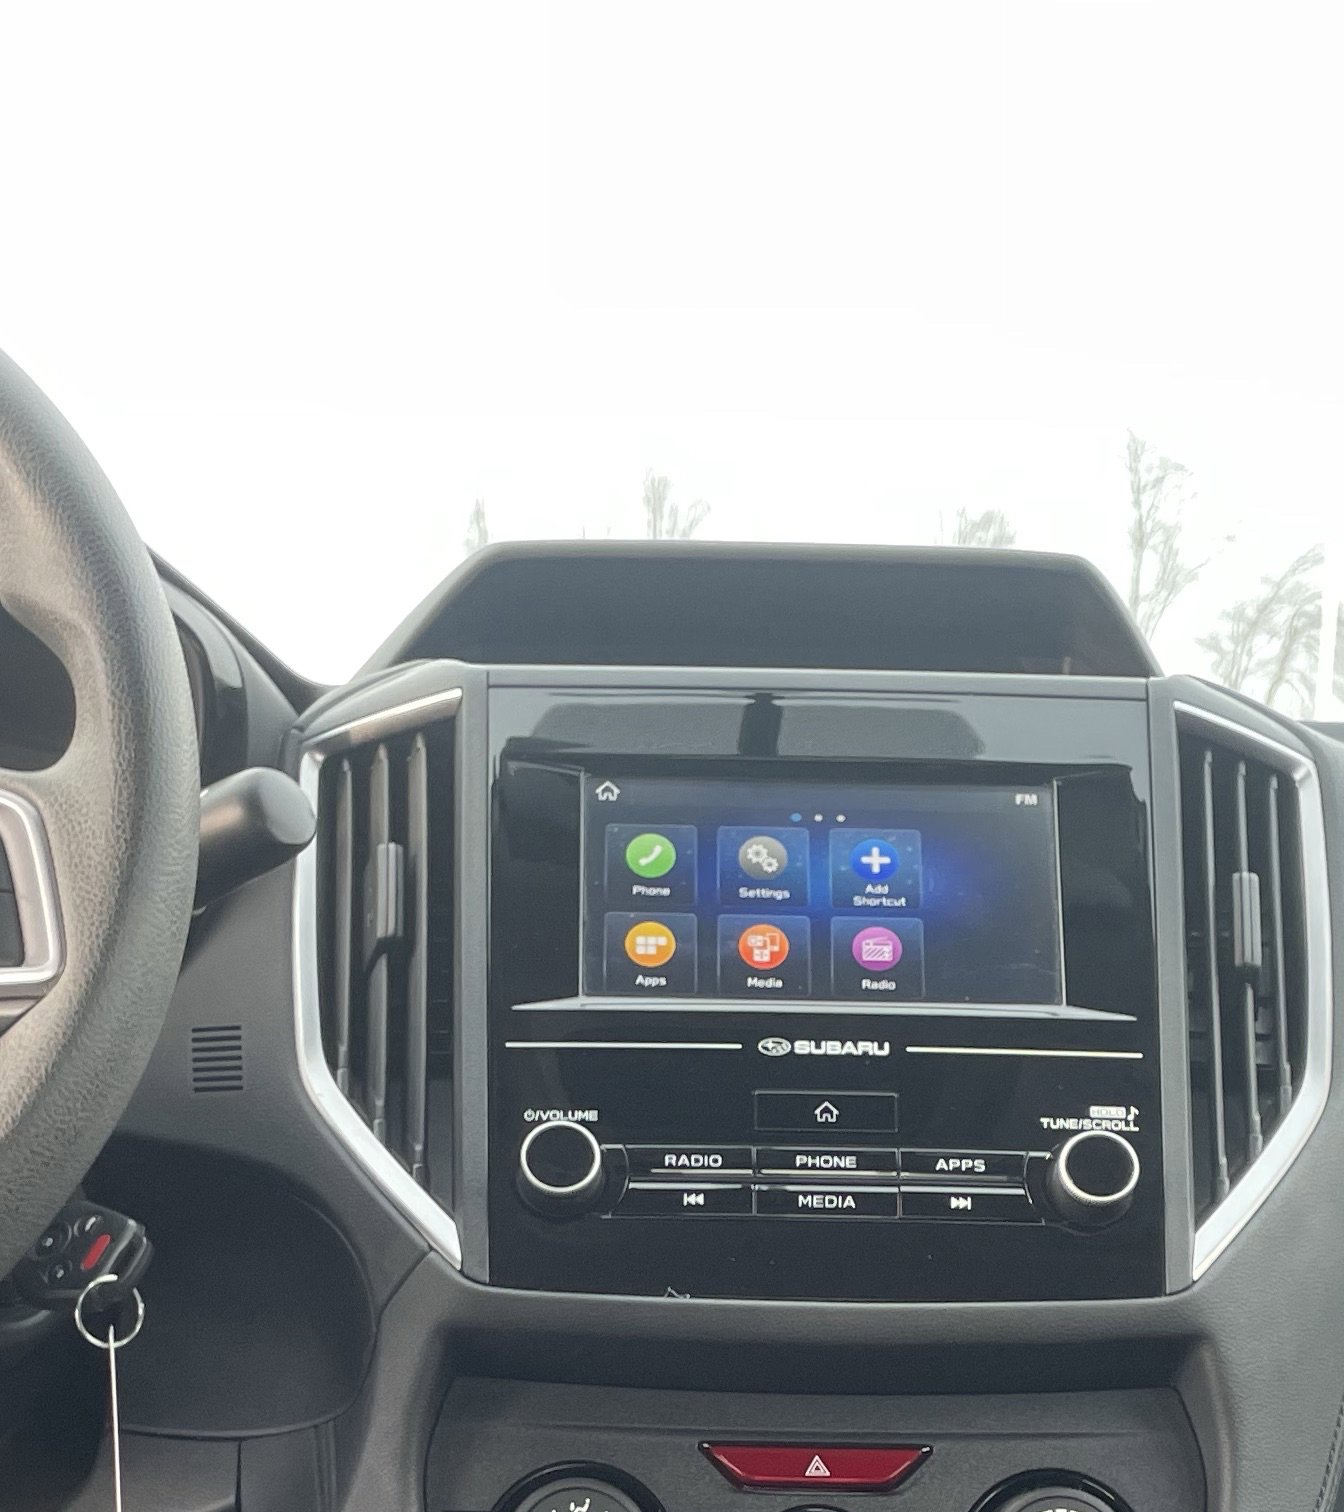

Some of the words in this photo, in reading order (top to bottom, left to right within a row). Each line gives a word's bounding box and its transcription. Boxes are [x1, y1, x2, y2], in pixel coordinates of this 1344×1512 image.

[632, 885, 670, 897] Phone
[738, 887, 790, 900] Settings
[864, 884, 889, 895] Add
[852, 896, 906, 908] Shortcut
[635, 974, 667, 988] Apps
[747, 976, 783, 989] Media
[861, 978, 896, 991] Radio
[793, 1039, 890, 1056] SUBARU
[1040, 1117, 1140, 1131] TUNE/SCROLL
[664, 1154, 723, 1168] RADIO
[795, 1155, 857, 1168] PHONE
[935, 1158, 986, 1173] APPS
[798, 1194, 856, 1209] MEDIA
